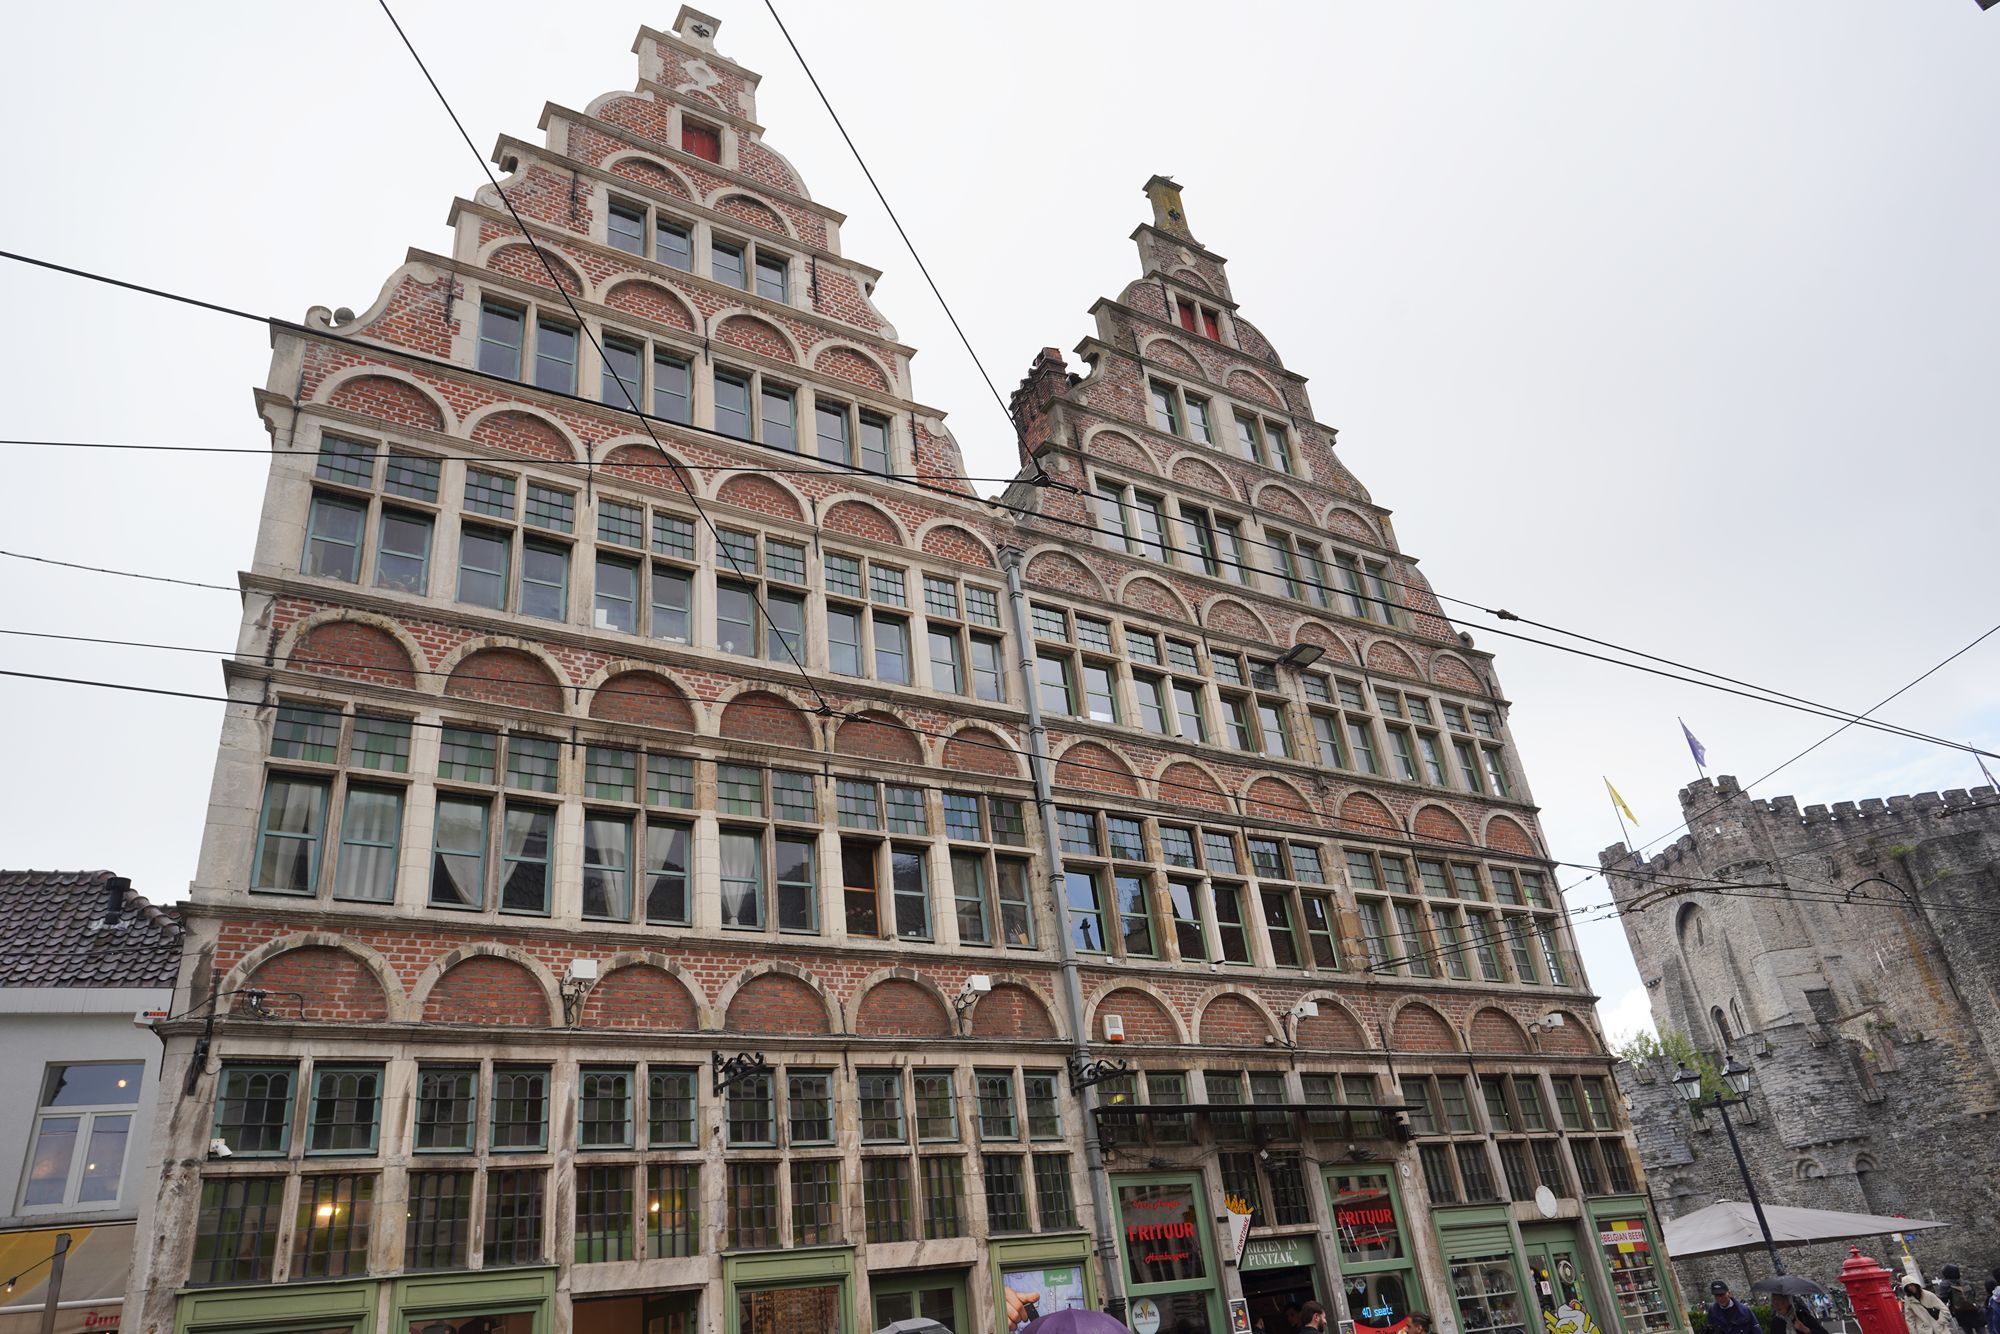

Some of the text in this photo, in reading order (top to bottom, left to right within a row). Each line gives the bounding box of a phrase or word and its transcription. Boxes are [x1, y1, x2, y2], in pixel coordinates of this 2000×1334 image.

[1337, 1208, 1393, 1227] FRITUUR
[1127, 1222, 1195, 1242] FRITUUR
[1628, 1231, 1642, 1240] BEER
[1246, 1240, 1281, 1254] RIETEN
[1248, 1251, 1294, 1267] PUNTZAK
[1362, 1306, 1372, 1318] 40
